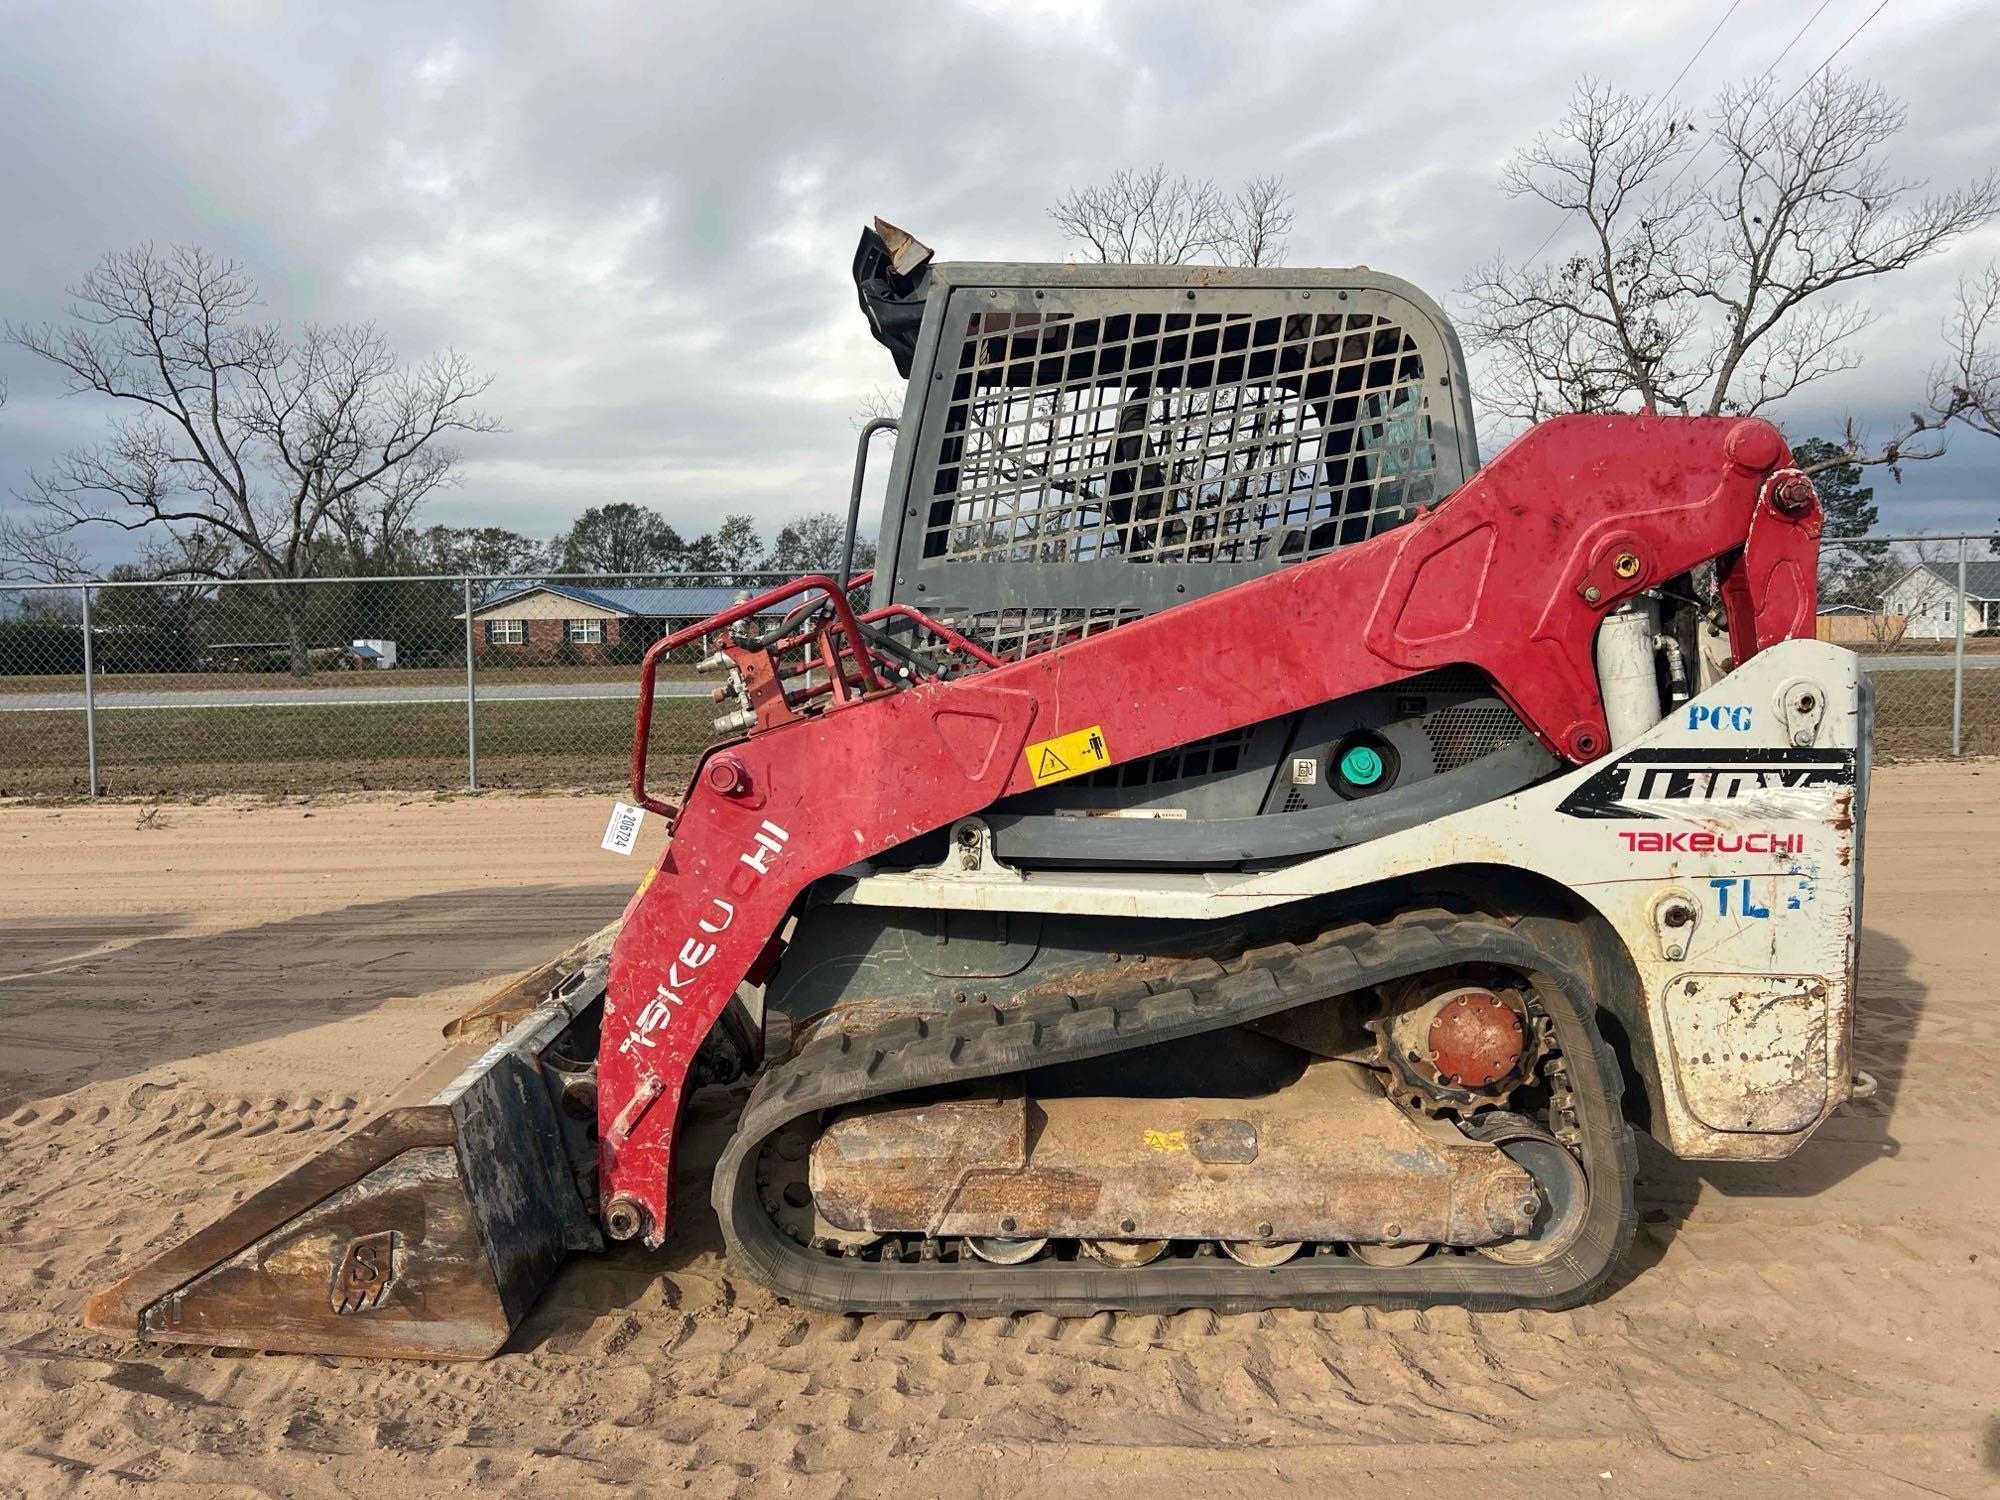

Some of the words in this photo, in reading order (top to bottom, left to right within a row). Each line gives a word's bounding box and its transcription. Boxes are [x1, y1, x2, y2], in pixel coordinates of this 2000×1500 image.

[1688, 705, 1753, 732] PCG
[614, 814, 637, 847] 206724
[1619, 832, 1804, 853] TAKEUCHI
